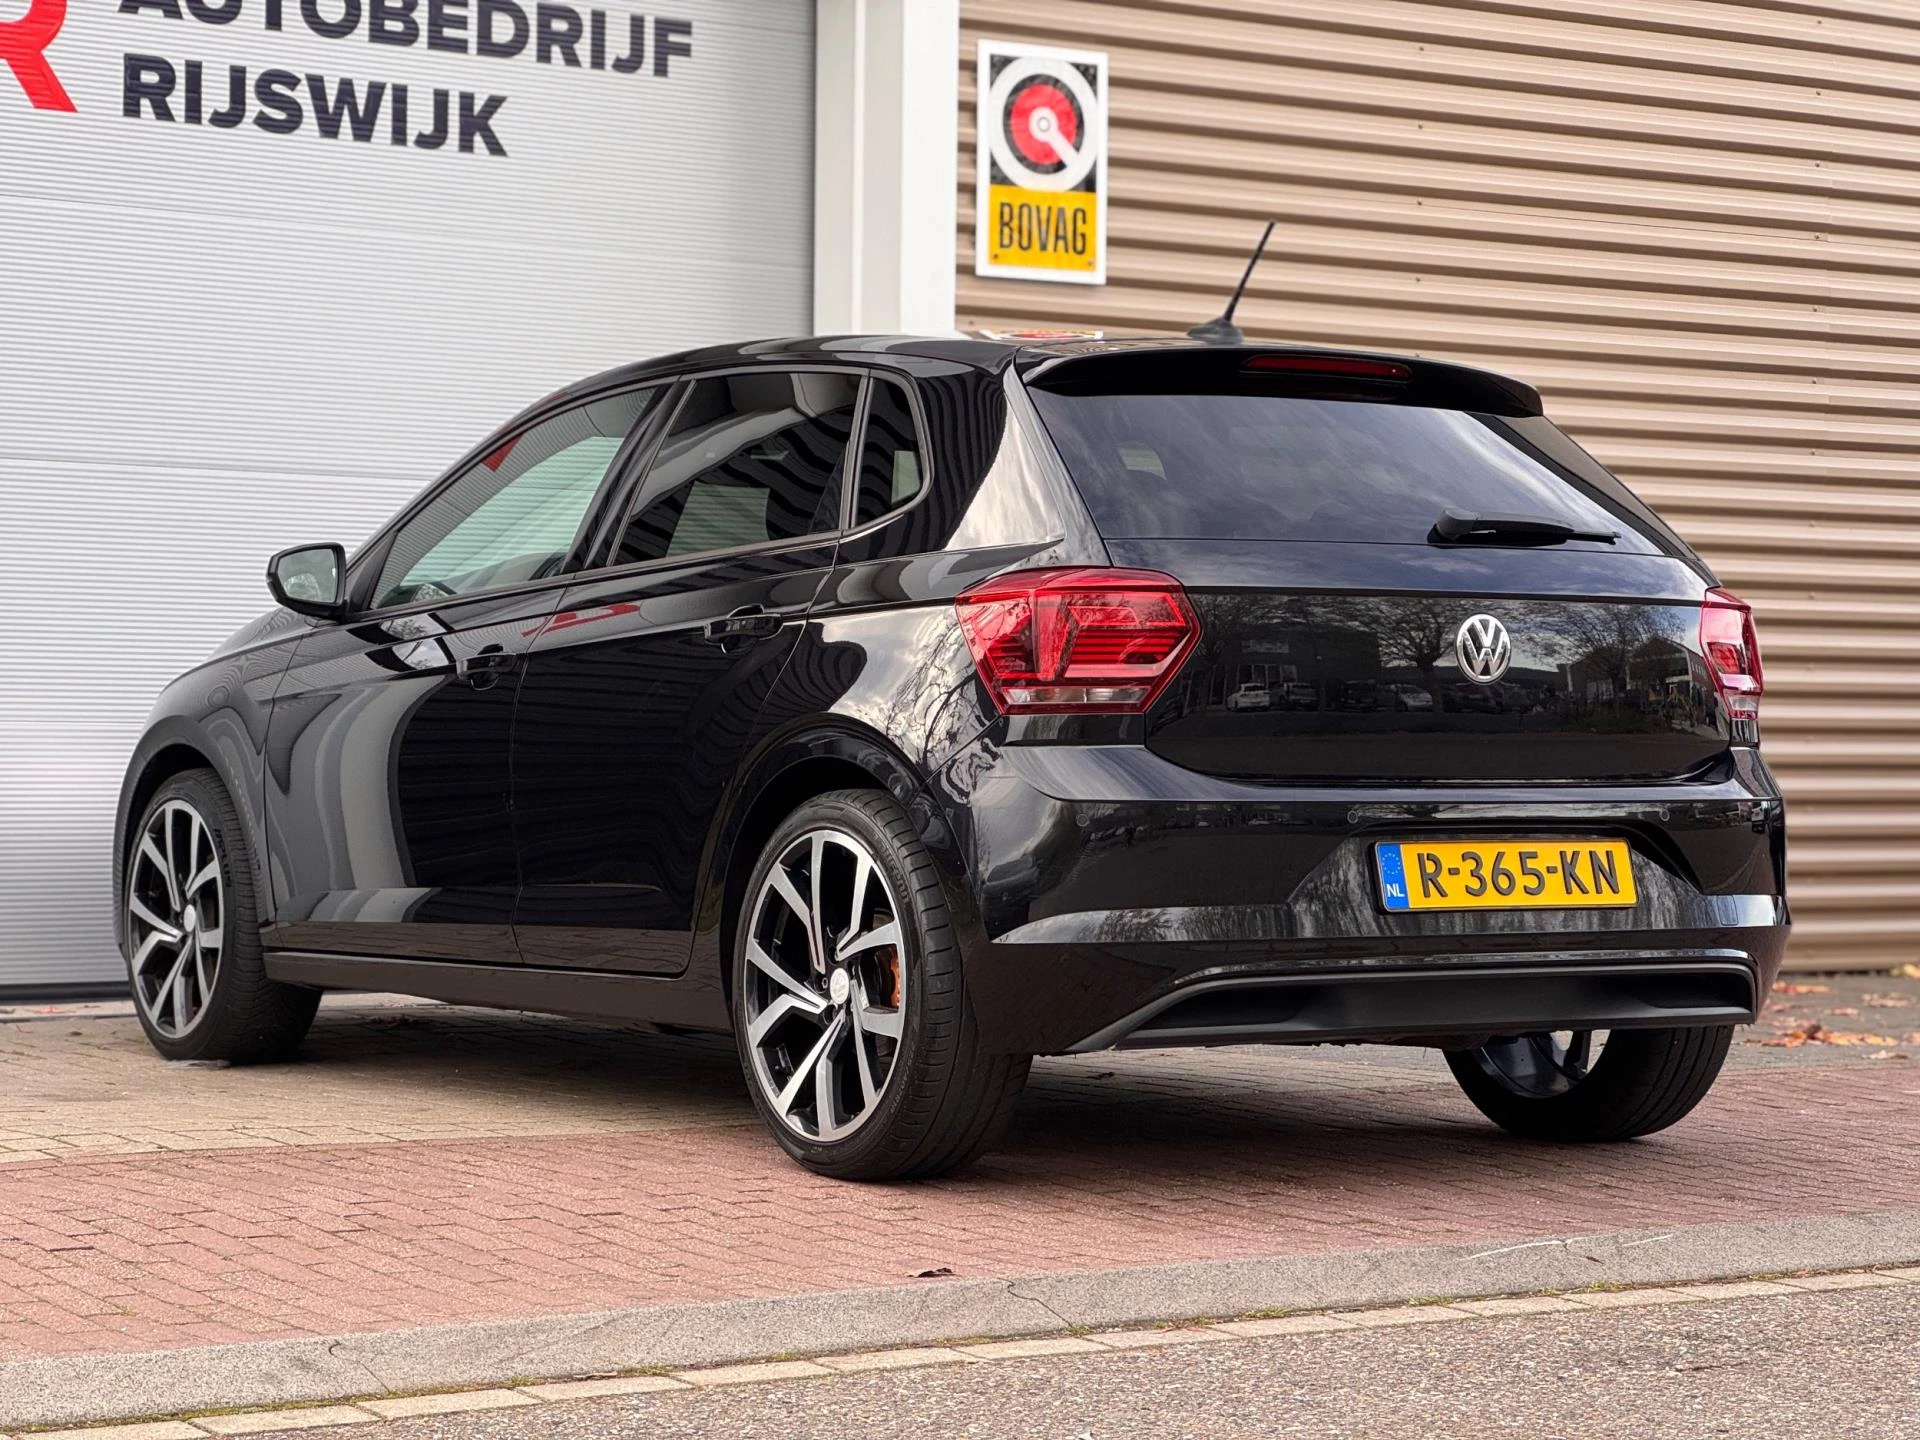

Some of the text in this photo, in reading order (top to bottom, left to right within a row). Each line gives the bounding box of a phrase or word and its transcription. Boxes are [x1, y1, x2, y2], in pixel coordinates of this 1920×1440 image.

[118, 0, 692, 77] OBEDRIJF
[123, 53, 507, 157] RIJSWIJK
[999, 202, 1087, 256] BOVAG
[1386, 850, 1620, 898] NL R-365-KN
